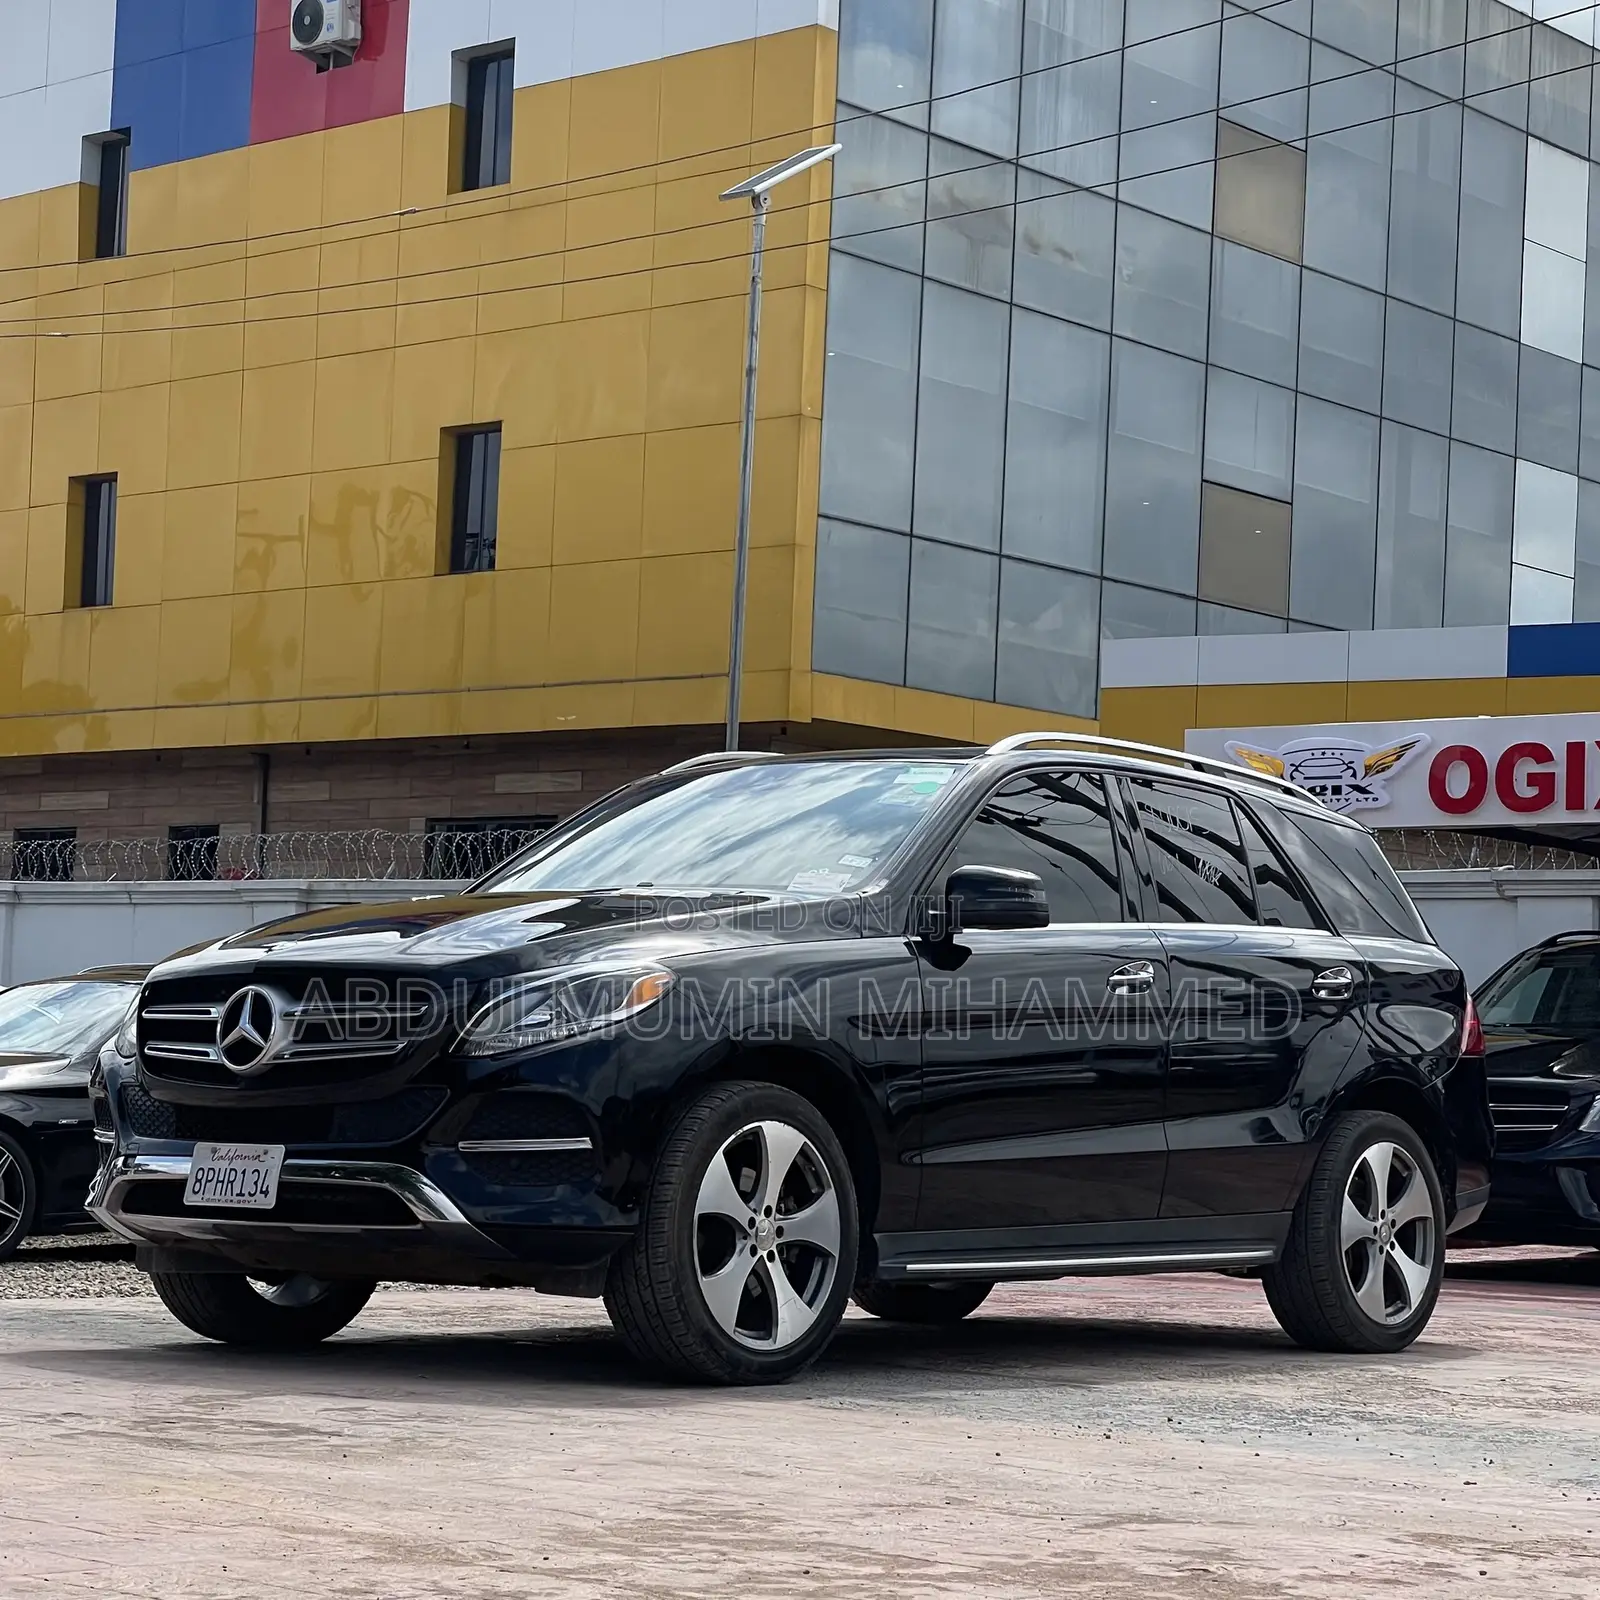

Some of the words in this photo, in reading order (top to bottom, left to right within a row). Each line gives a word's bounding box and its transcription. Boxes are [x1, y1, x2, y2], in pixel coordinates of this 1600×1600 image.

[1428, 740, 1600, 816] OGI
[211, 1147, 266, 1167] California
[191, 1167, 270, 1199] 8PHR134
